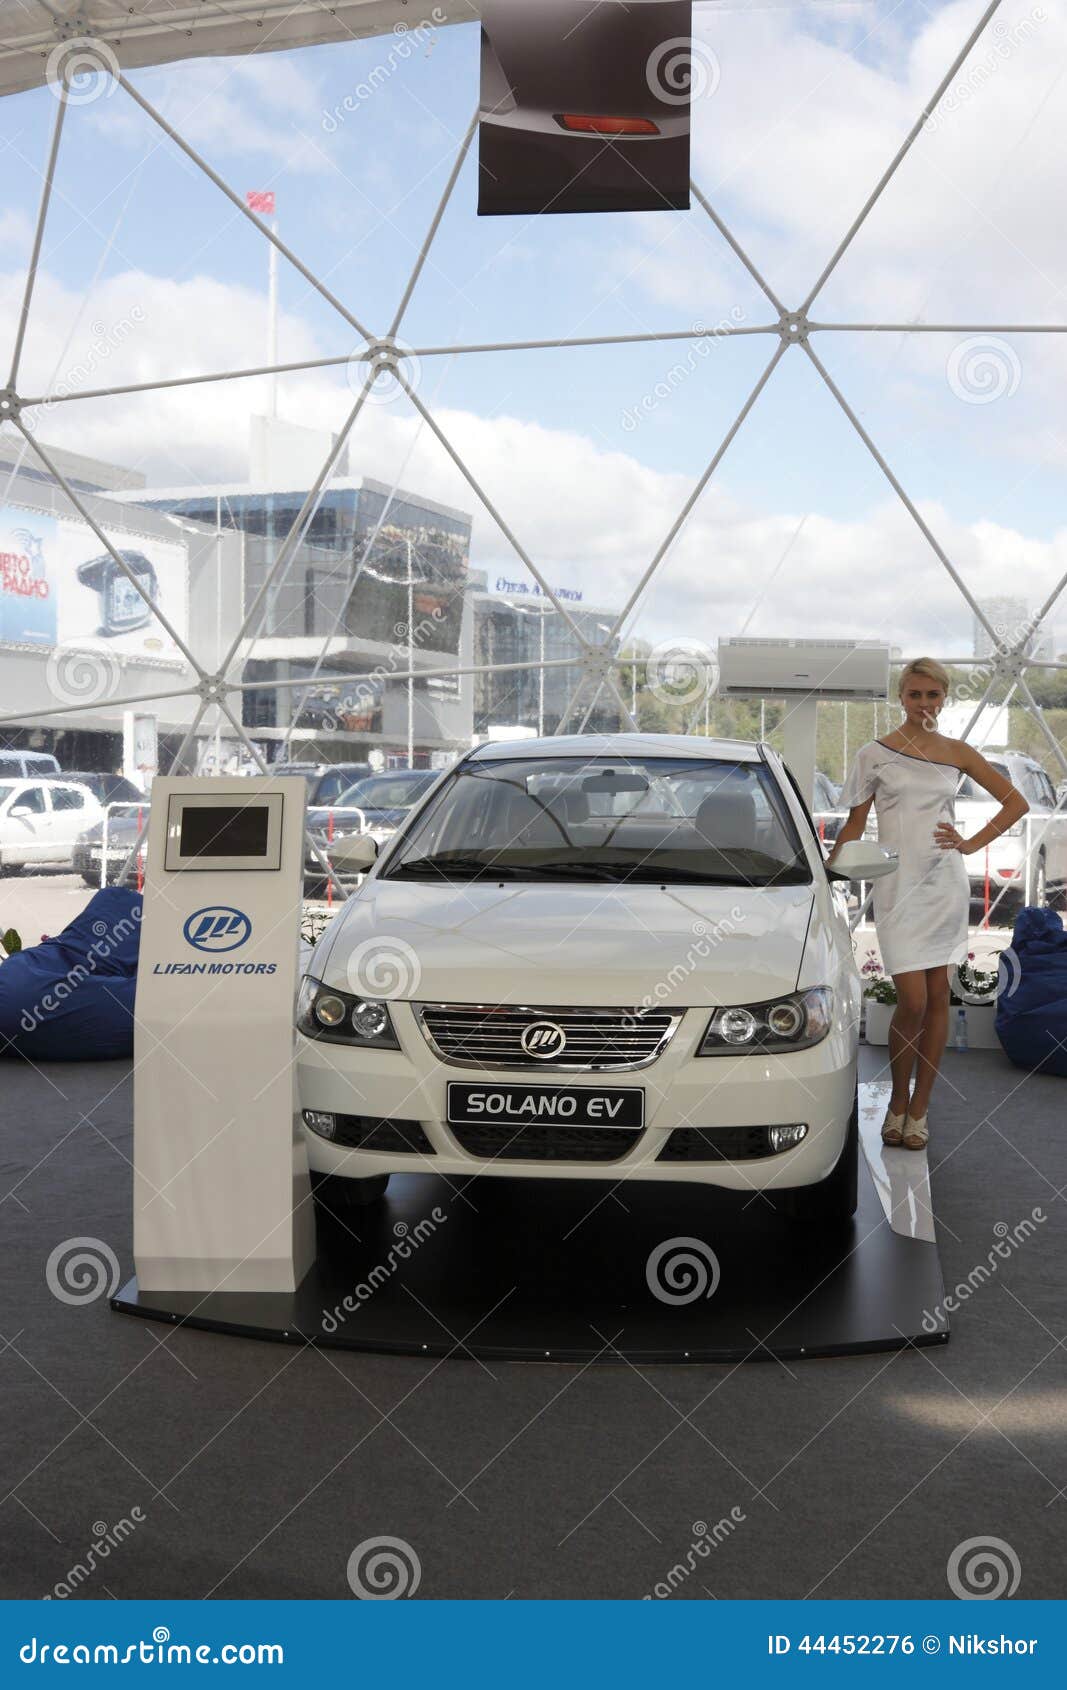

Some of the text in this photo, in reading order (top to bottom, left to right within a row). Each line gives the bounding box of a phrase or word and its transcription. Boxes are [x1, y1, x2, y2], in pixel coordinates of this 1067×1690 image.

[152, 963, 278, 975] LIFAN MOTORS
[466, 1093, 625, 1118] SOLANO EV
